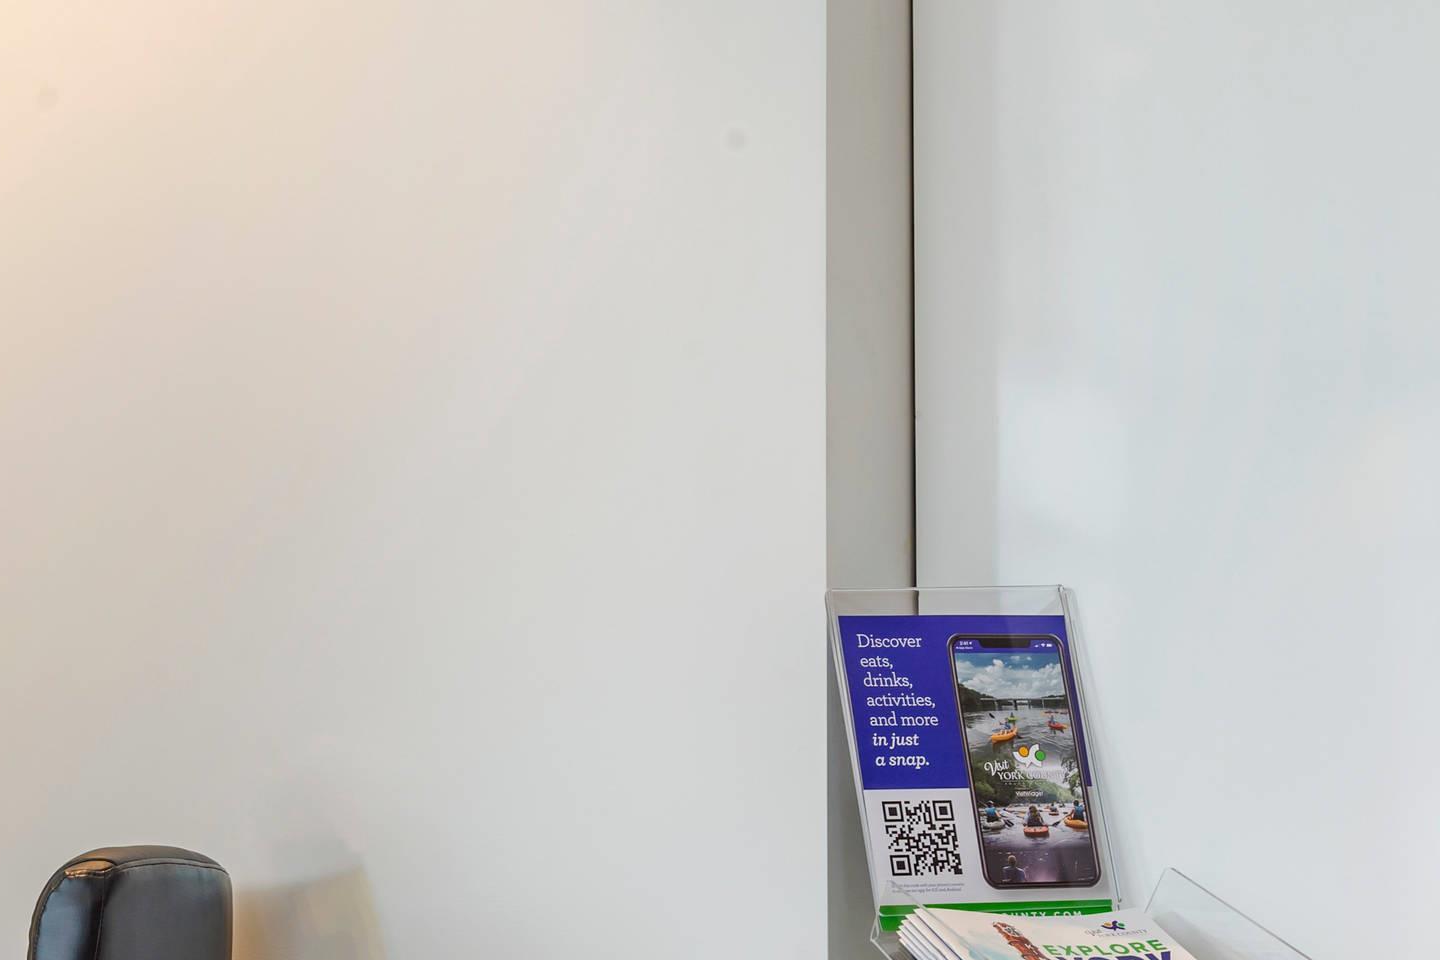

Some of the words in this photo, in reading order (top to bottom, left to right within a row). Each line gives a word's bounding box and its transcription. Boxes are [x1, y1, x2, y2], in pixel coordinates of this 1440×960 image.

[856, 633, 922, 648] Discover
[860, 655, 894, 670] eats,
[863, 671, 913, 689] drinks,
[866, 692, 936, 709] activities,
[869, 710, 898, 727] and
[900, 715, 939, 727] more
[872, 732, 889, 747] in
[889, 732, 920, 750] just
[875, 755, 886, 767] a
[888, 755, 930, 770] snap.
[983, 759, 1010, 777] Visit
[996, 769, 1025, 781] YORK
[1042, 939, 1168, 957] EXPLORE
